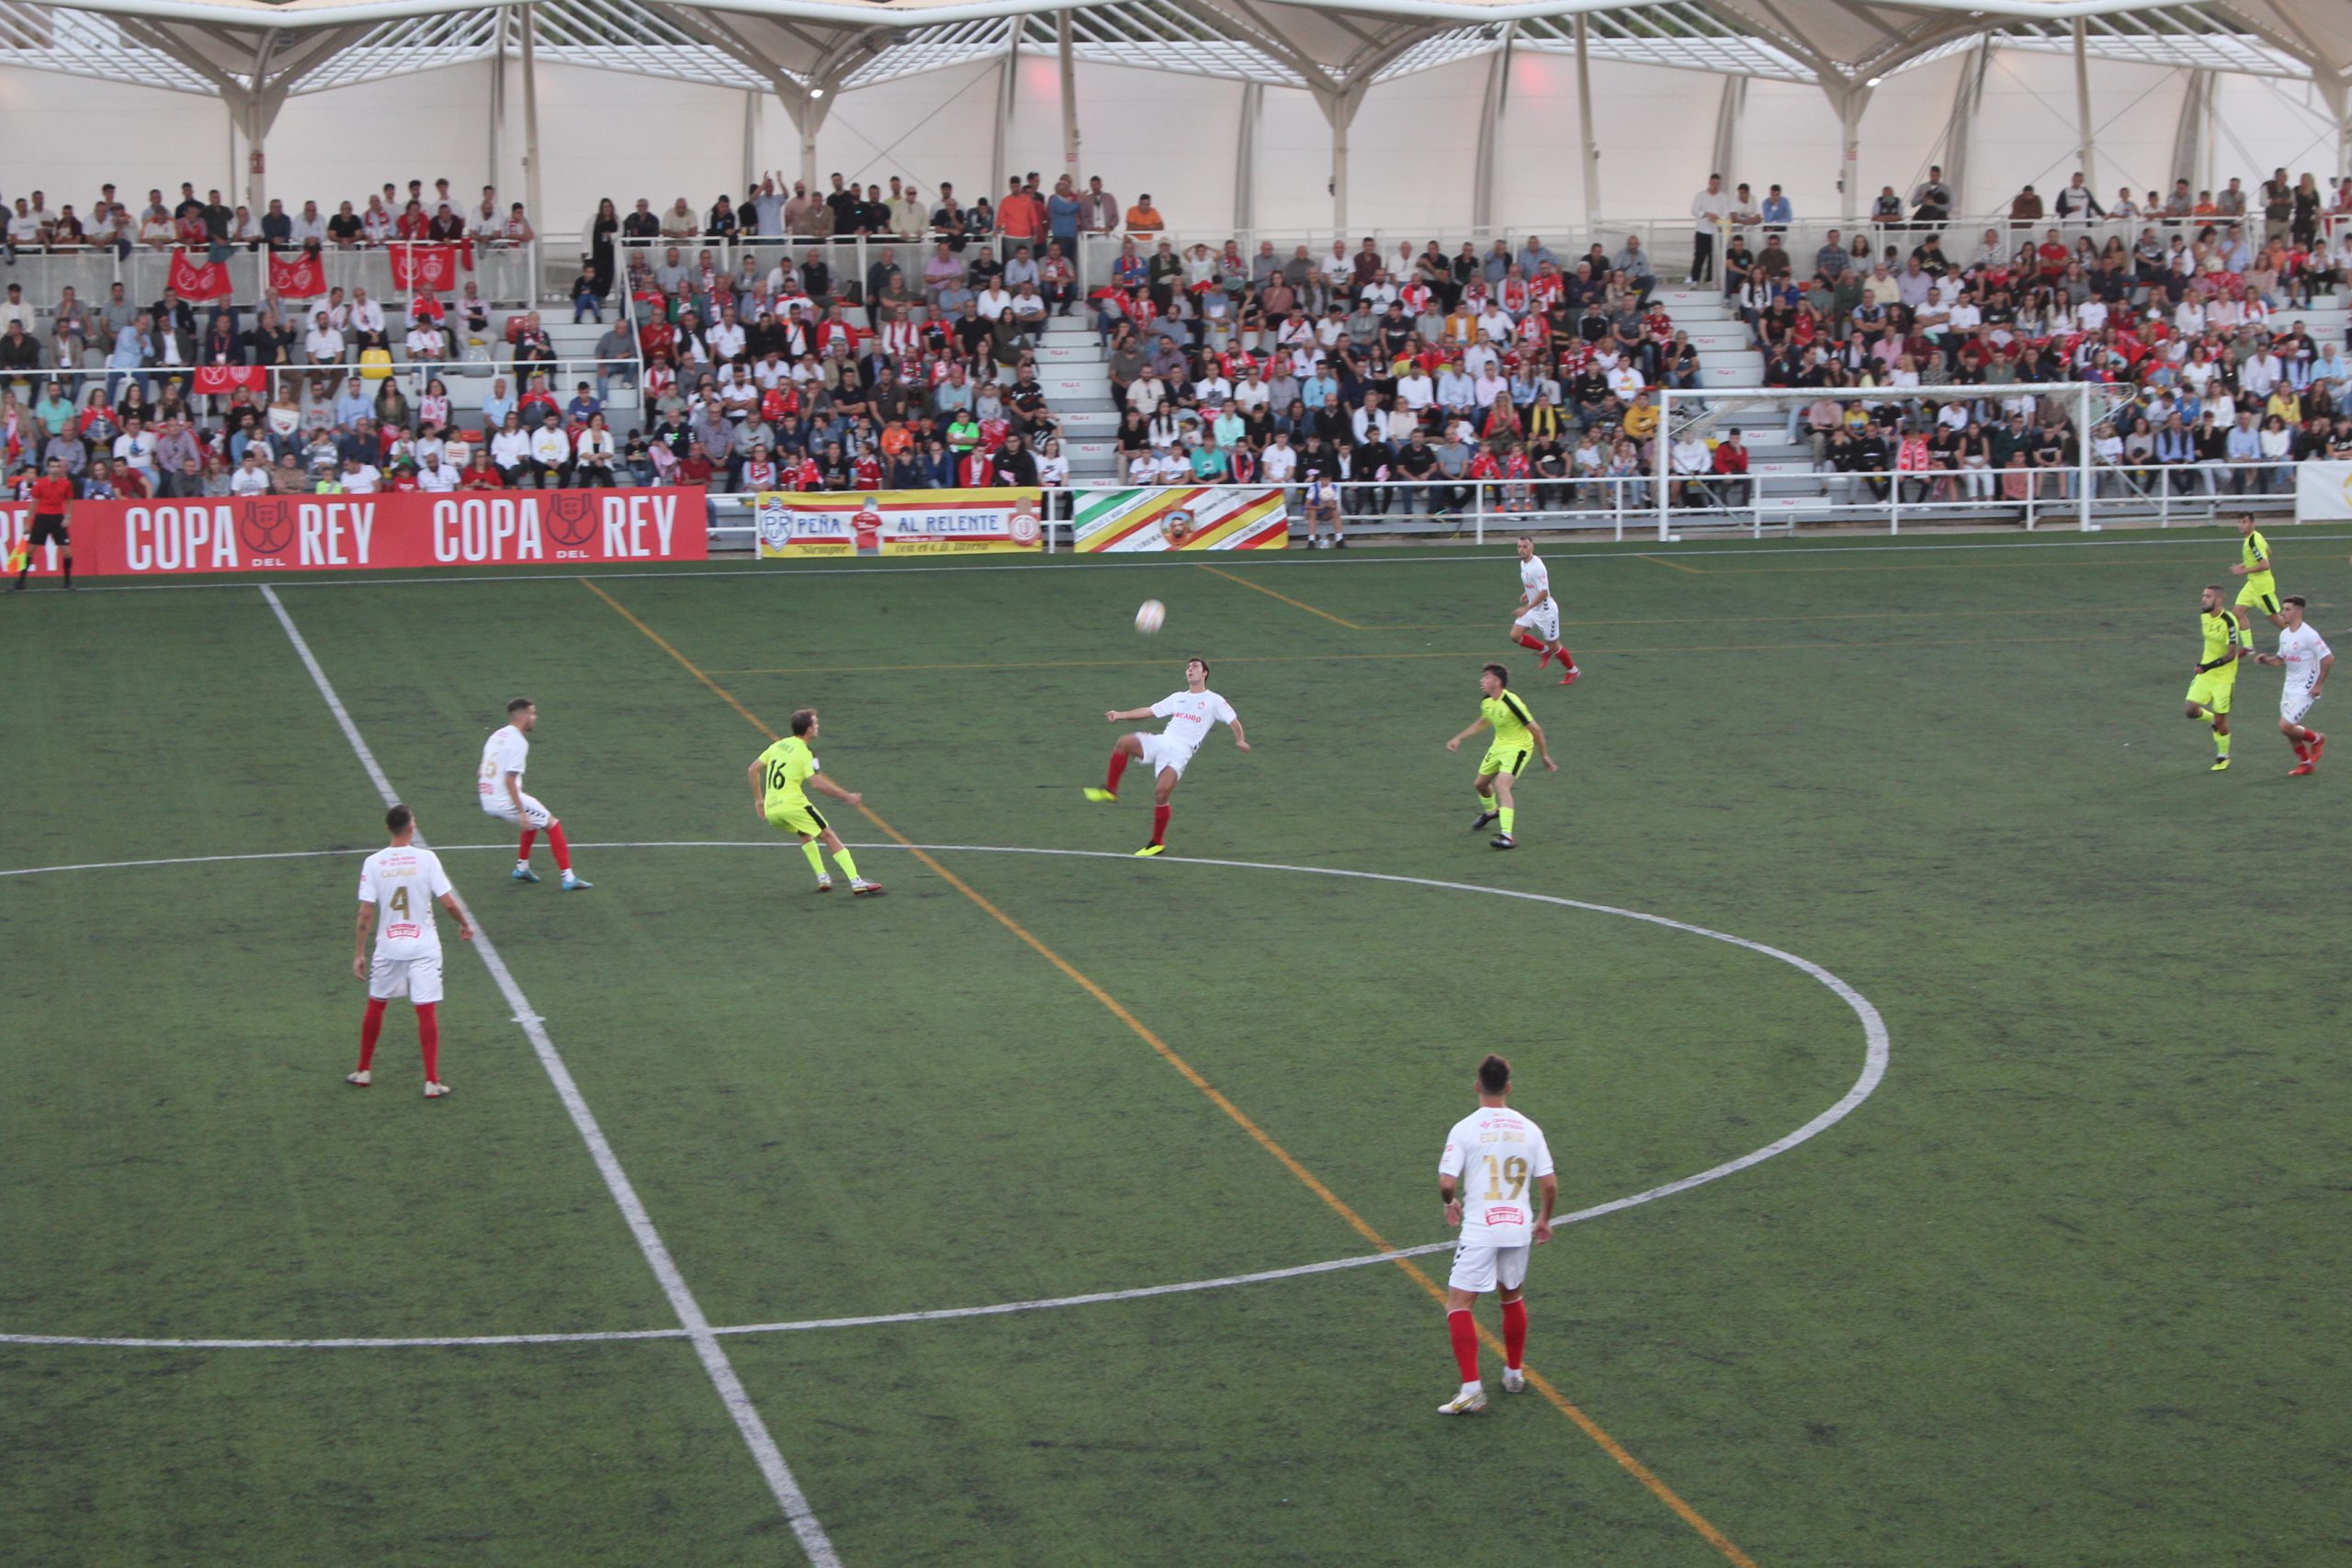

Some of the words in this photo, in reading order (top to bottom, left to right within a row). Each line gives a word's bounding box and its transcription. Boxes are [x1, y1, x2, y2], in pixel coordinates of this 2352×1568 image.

[125, 505, 239, 570] COPA
[251, 558, 286, 568] DEL
[299, 502, 376, 566] REY
[433, 498, 543, 562] COPA
[556, 550, 590, 558] DEL
[603, 495, 677, 558] REY
[797, 514, 842, 534] PEÑA
[898, 516, 919, 533] AL
[926, 514, 1000, 532] RELENTE
[768, 759, 786, 790] 16
[389, 886, 410, 920] 4
[1483, 1154, 1528, 1201] 19
